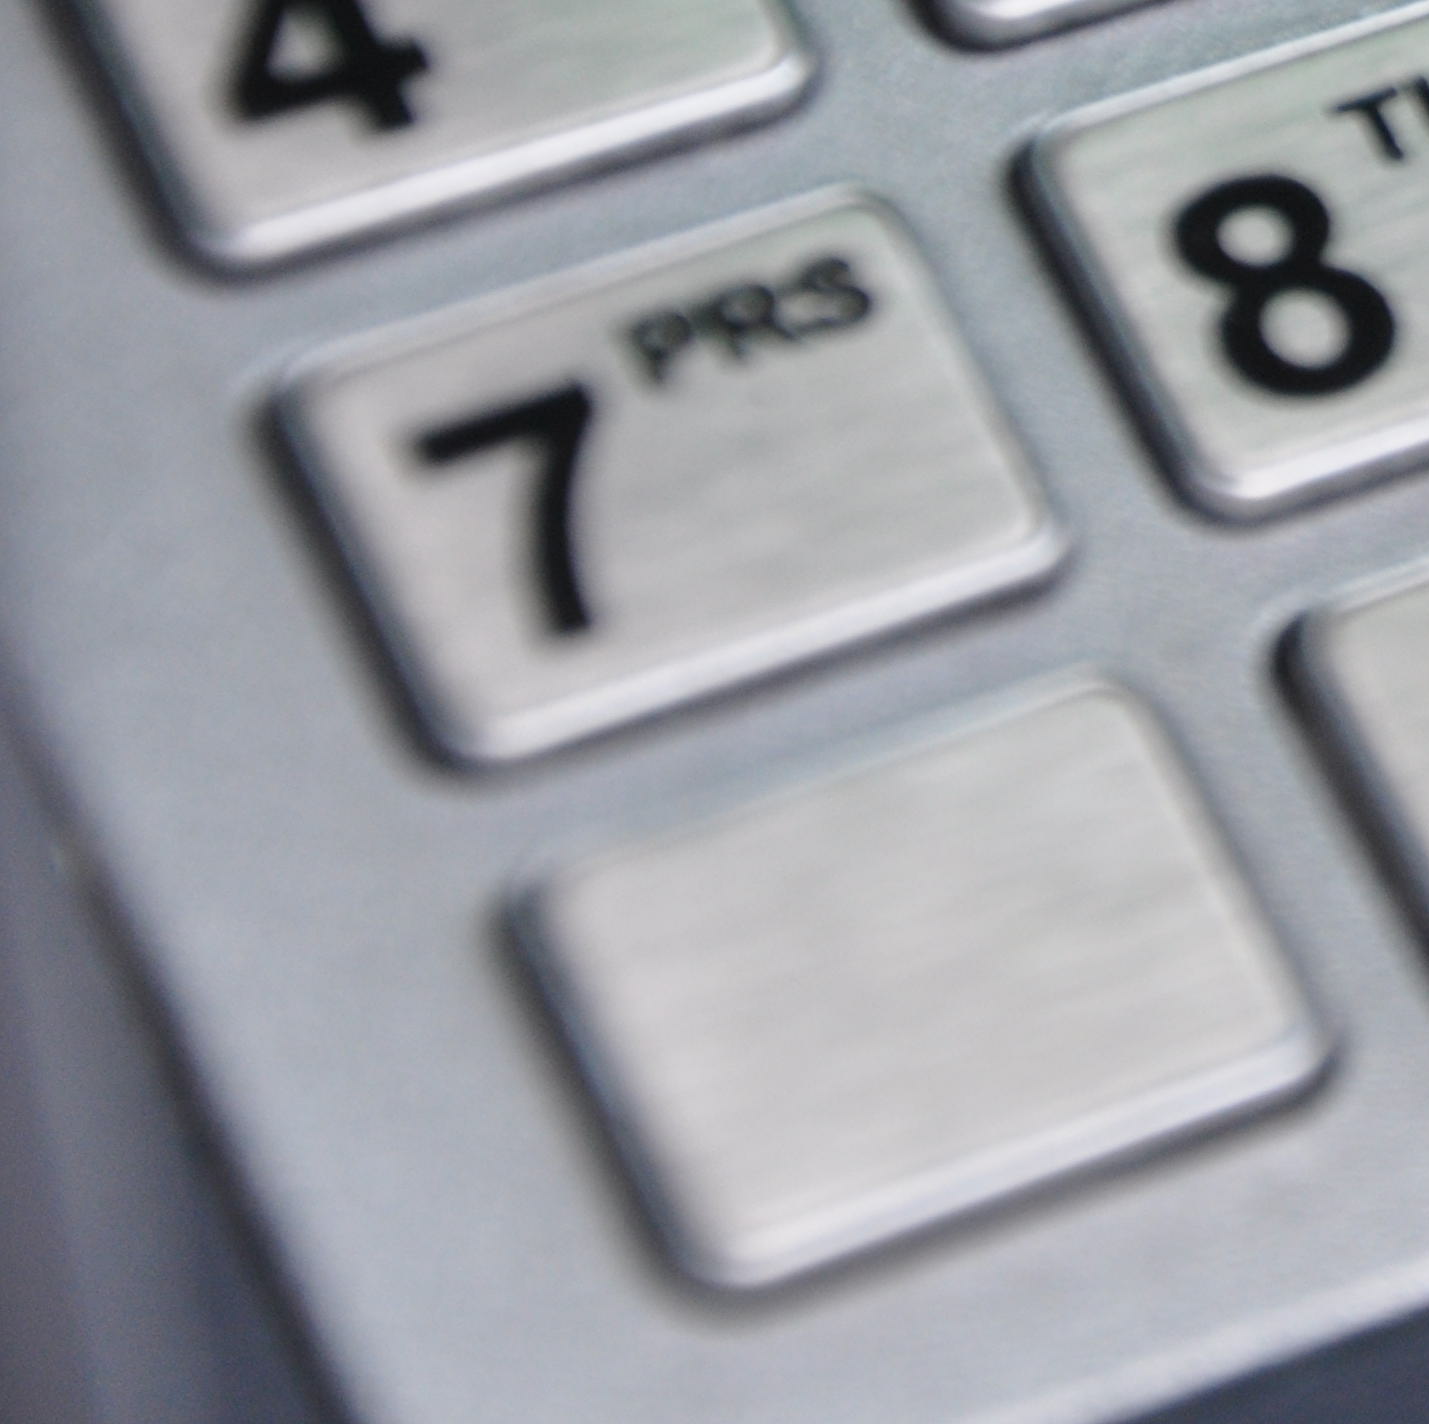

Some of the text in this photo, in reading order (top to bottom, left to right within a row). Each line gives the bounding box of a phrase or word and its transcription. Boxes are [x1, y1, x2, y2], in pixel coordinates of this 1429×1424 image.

[620, 256, 875, 388] PRS
[1172, 173, 1395, 398] 8
[412, 381, 594, 636] 7
